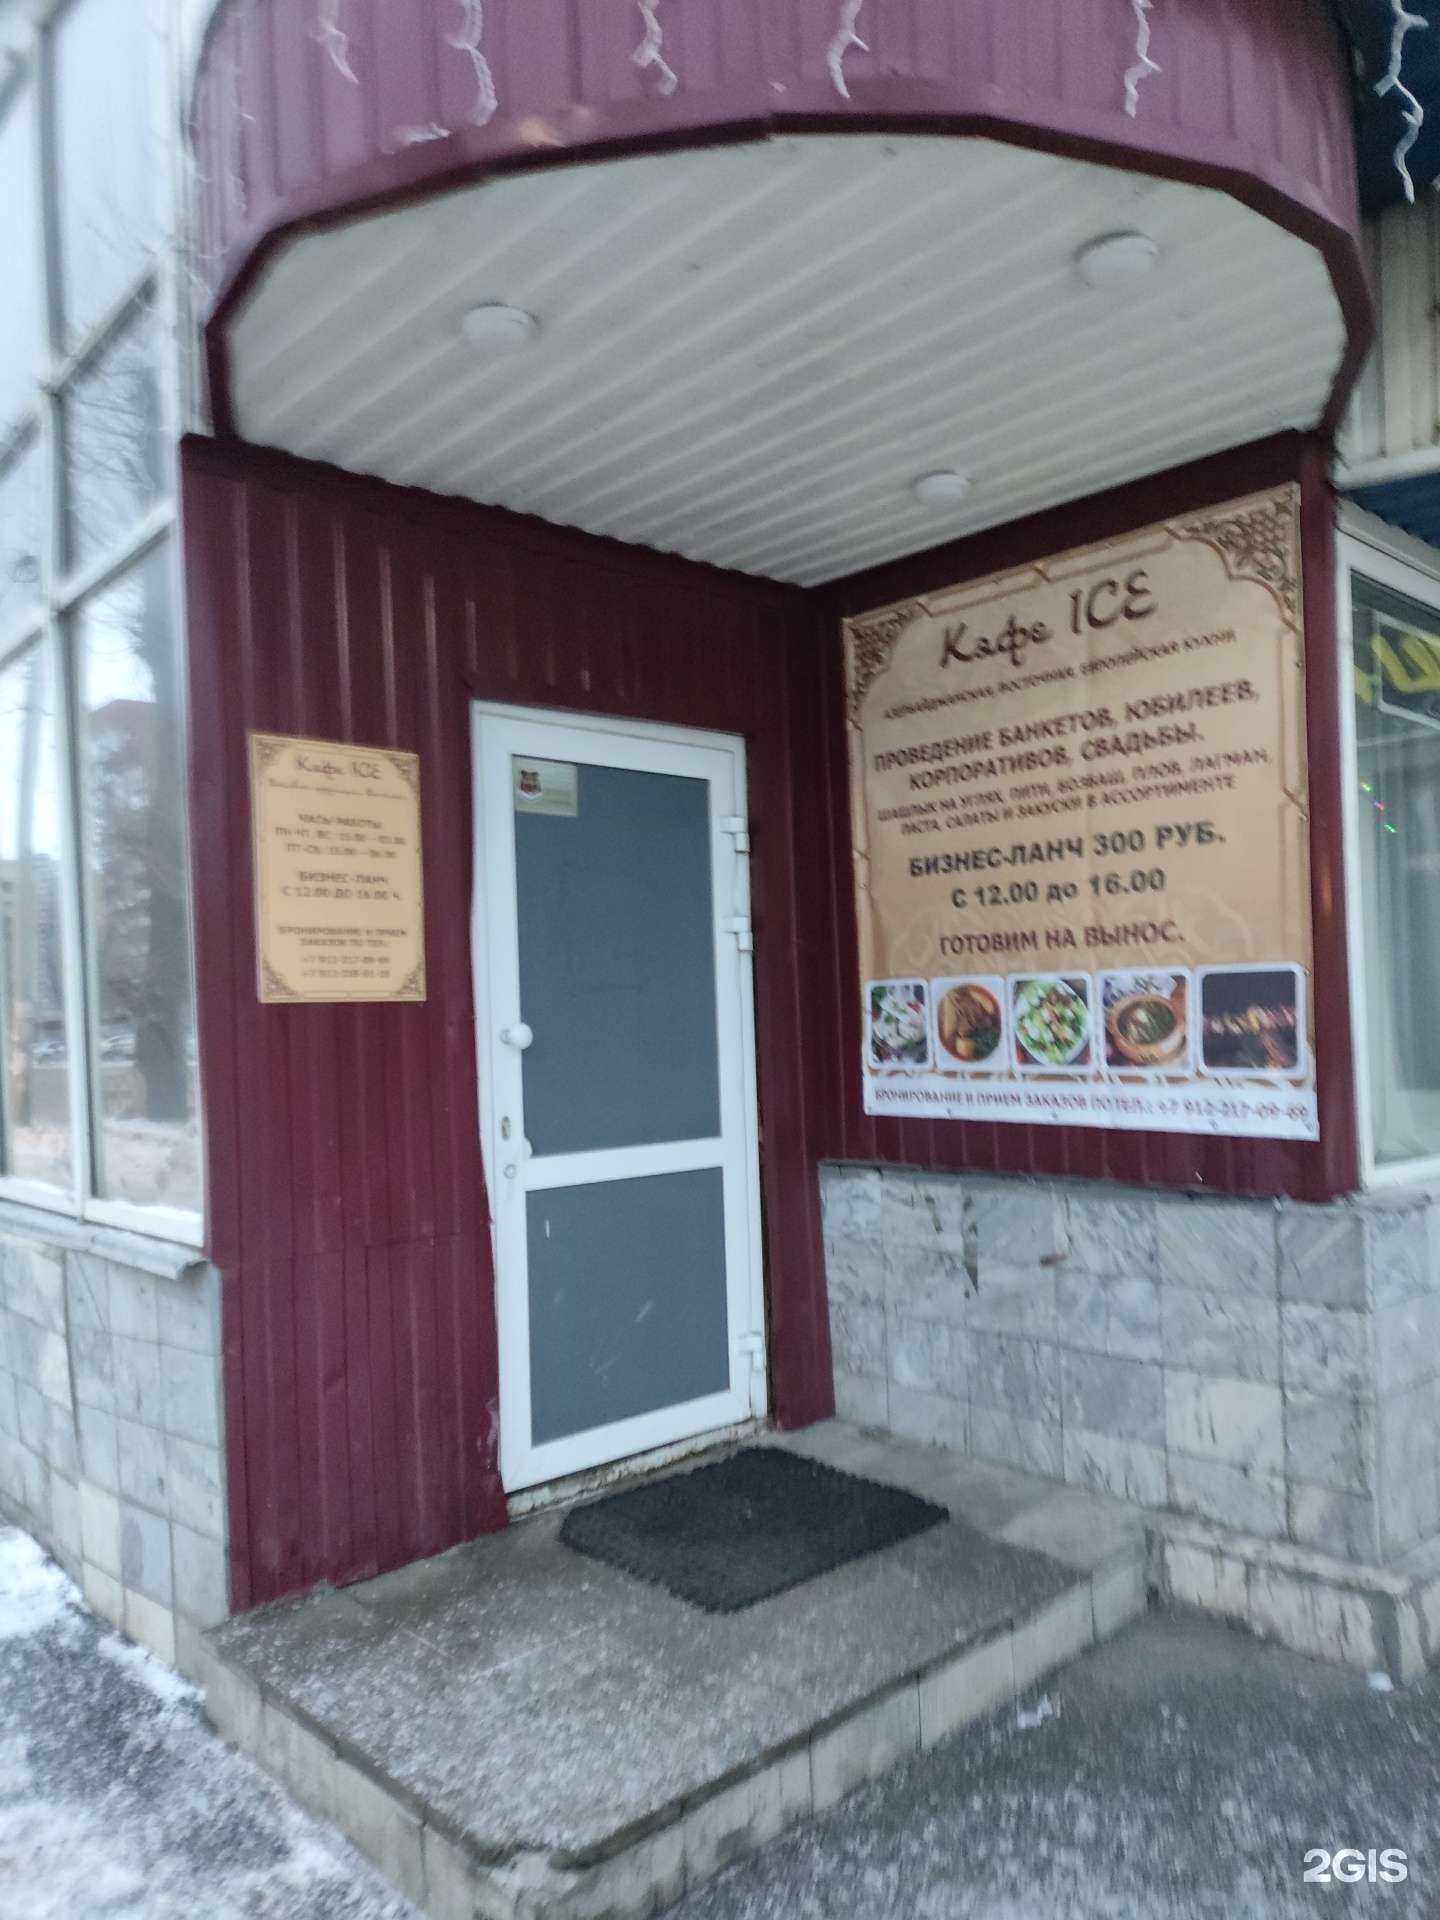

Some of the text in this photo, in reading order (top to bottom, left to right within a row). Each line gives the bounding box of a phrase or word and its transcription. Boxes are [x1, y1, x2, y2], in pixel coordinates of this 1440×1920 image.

[940, 569, 1158, 668] Кафе ICE
[873, 731, 994, 772] ПРОВЕДЕНИЕ
[908, 820, 1226, 877] БИЗНЕС-ЛАНЧ 300 РУБ.
[951, 866, 1167, 909] С 12.00 до 16.00
[939, 919, 1186, 957] ГОТОВИМ НА ВЫНОС.
